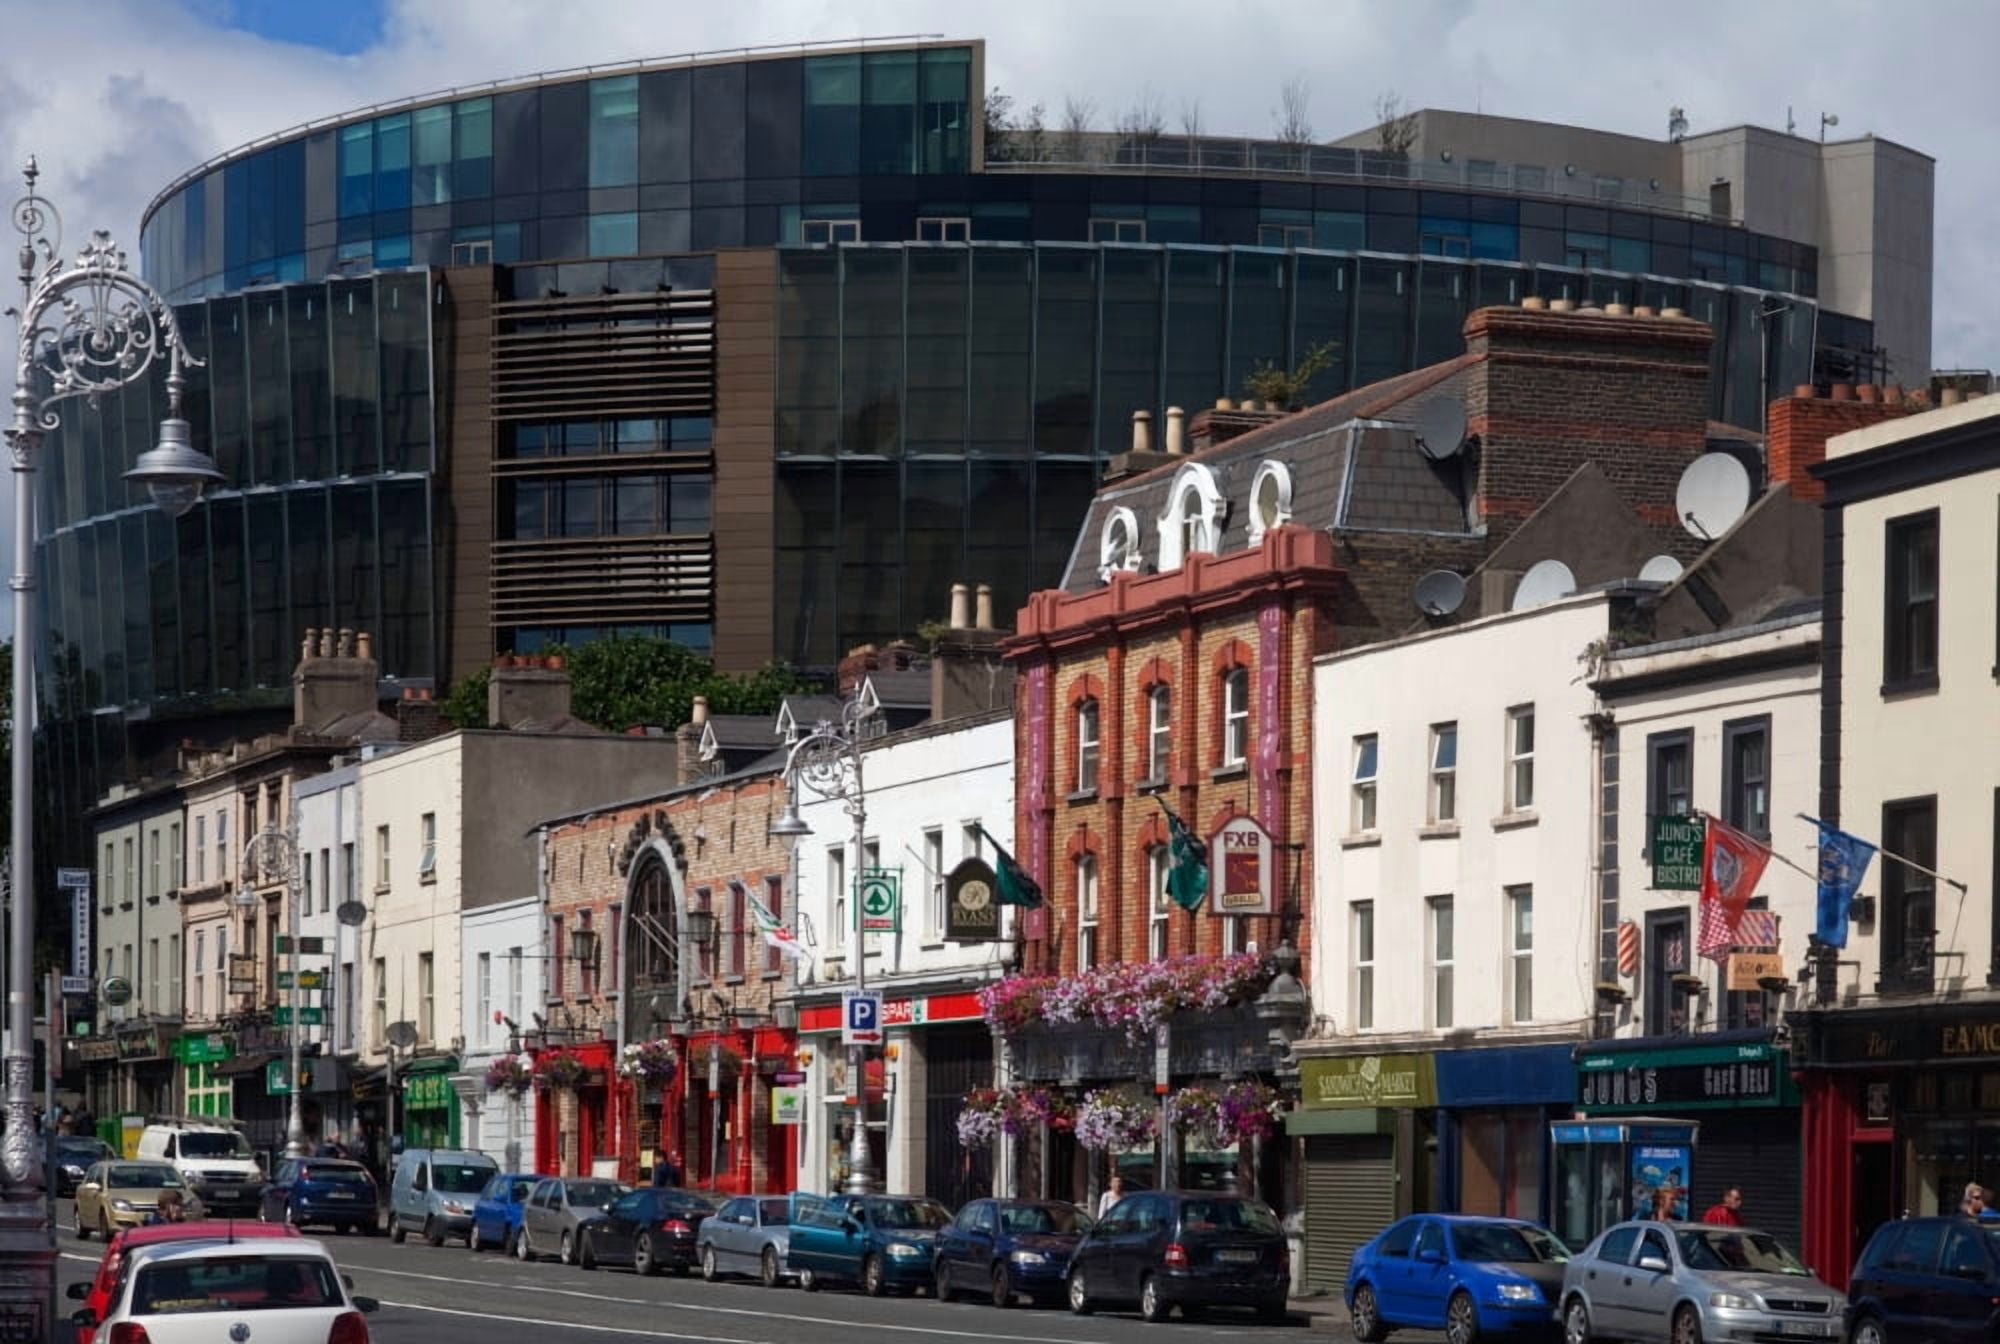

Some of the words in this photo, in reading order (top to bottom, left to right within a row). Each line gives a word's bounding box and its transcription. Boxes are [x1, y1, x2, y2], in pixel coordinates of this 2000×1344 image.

[1223, 831, 1259, 847] FXB
[1657, 824, 1703, 842] JUNO'S
[1664, 842, 1694, 865] CAFÉ
[1657, 866, 1702, 884] BISTRO
[853, 1002, 871, 1027] P
[882, 1001, 913, 1021] SPAR
